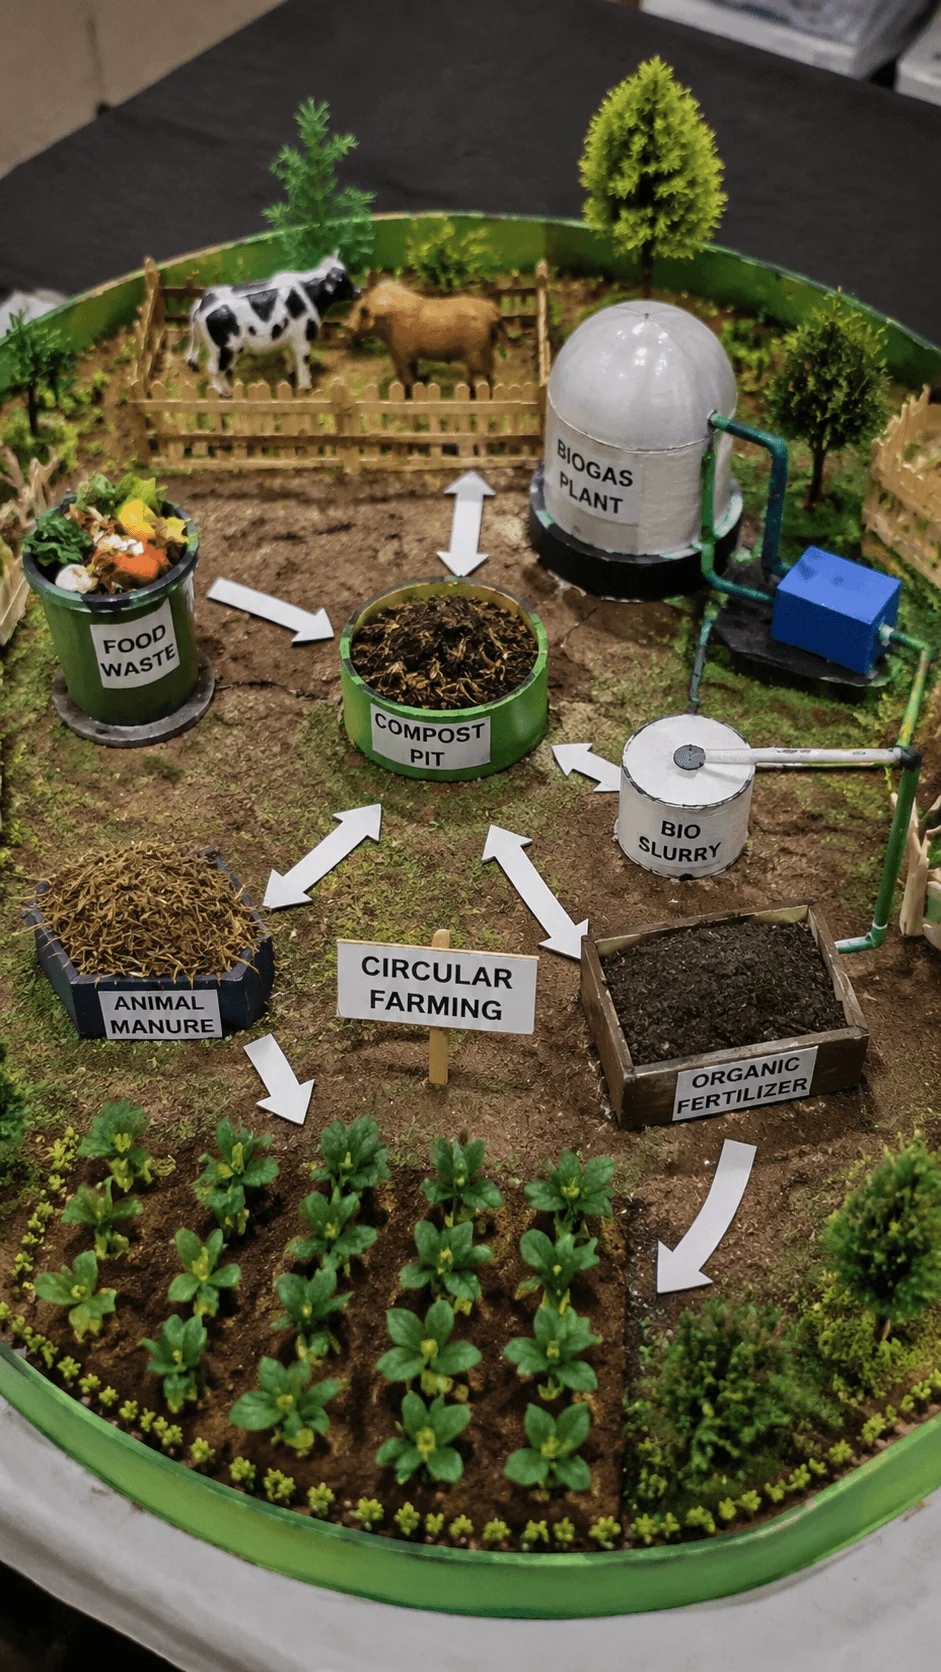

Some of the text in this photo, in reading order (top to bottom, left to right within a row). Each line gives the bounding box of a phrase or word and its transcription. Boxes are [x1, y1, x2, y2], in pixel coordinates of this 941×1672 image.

[557, 439, 633, 487] BIOGAS
[559, 471, 623, 514] PLANT
[103, 624, 166, 654] FOOD
[100, 643, 176, 677] WASTE
[375, 713, 485, 743] COMPOST
[410, 749, 445, 767] PIT
[661, 820, 701, 839] BIO
[638, 836, 722, 862] SLURRY
[361, 956, 513, 990] CIRCULAR
[114, 996, 204, 1011] ANIMAL
[369, 989, 502, 1021] FARMING
[110, 1019, 215, 1034] MANURE
[692, 1057, 800, 1088] ORGANIC
[677, 1078, 808, 1114] FERTILIZER
